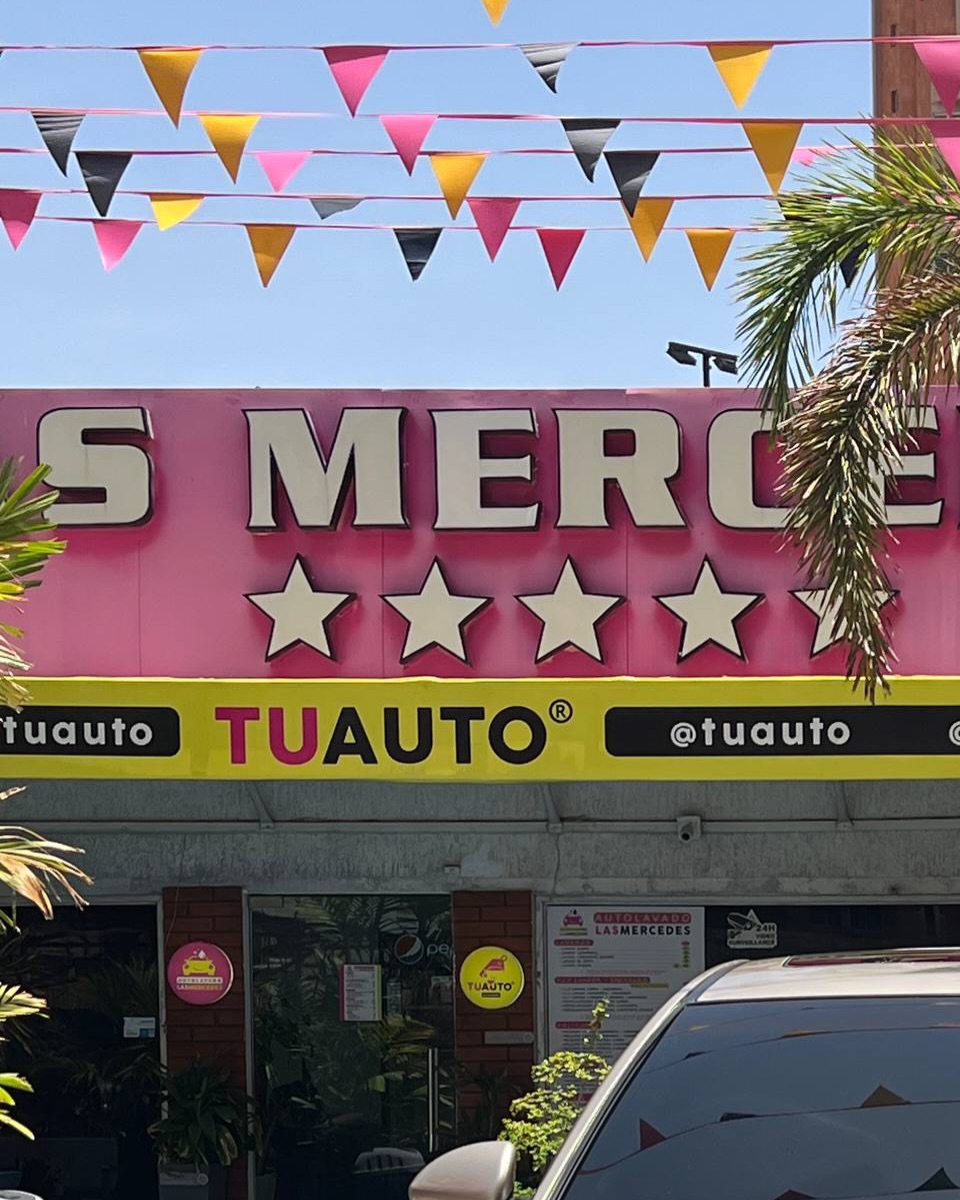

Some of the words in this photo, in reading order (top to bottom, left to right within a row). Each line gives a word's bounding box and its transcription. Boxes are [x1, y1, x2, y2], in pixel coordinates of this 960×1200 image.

[2, 716, 153, 746] tuauto
[670, 717, 851, 748] @tuauto
[594, 913, 690, 923] AUTOLAVADO
